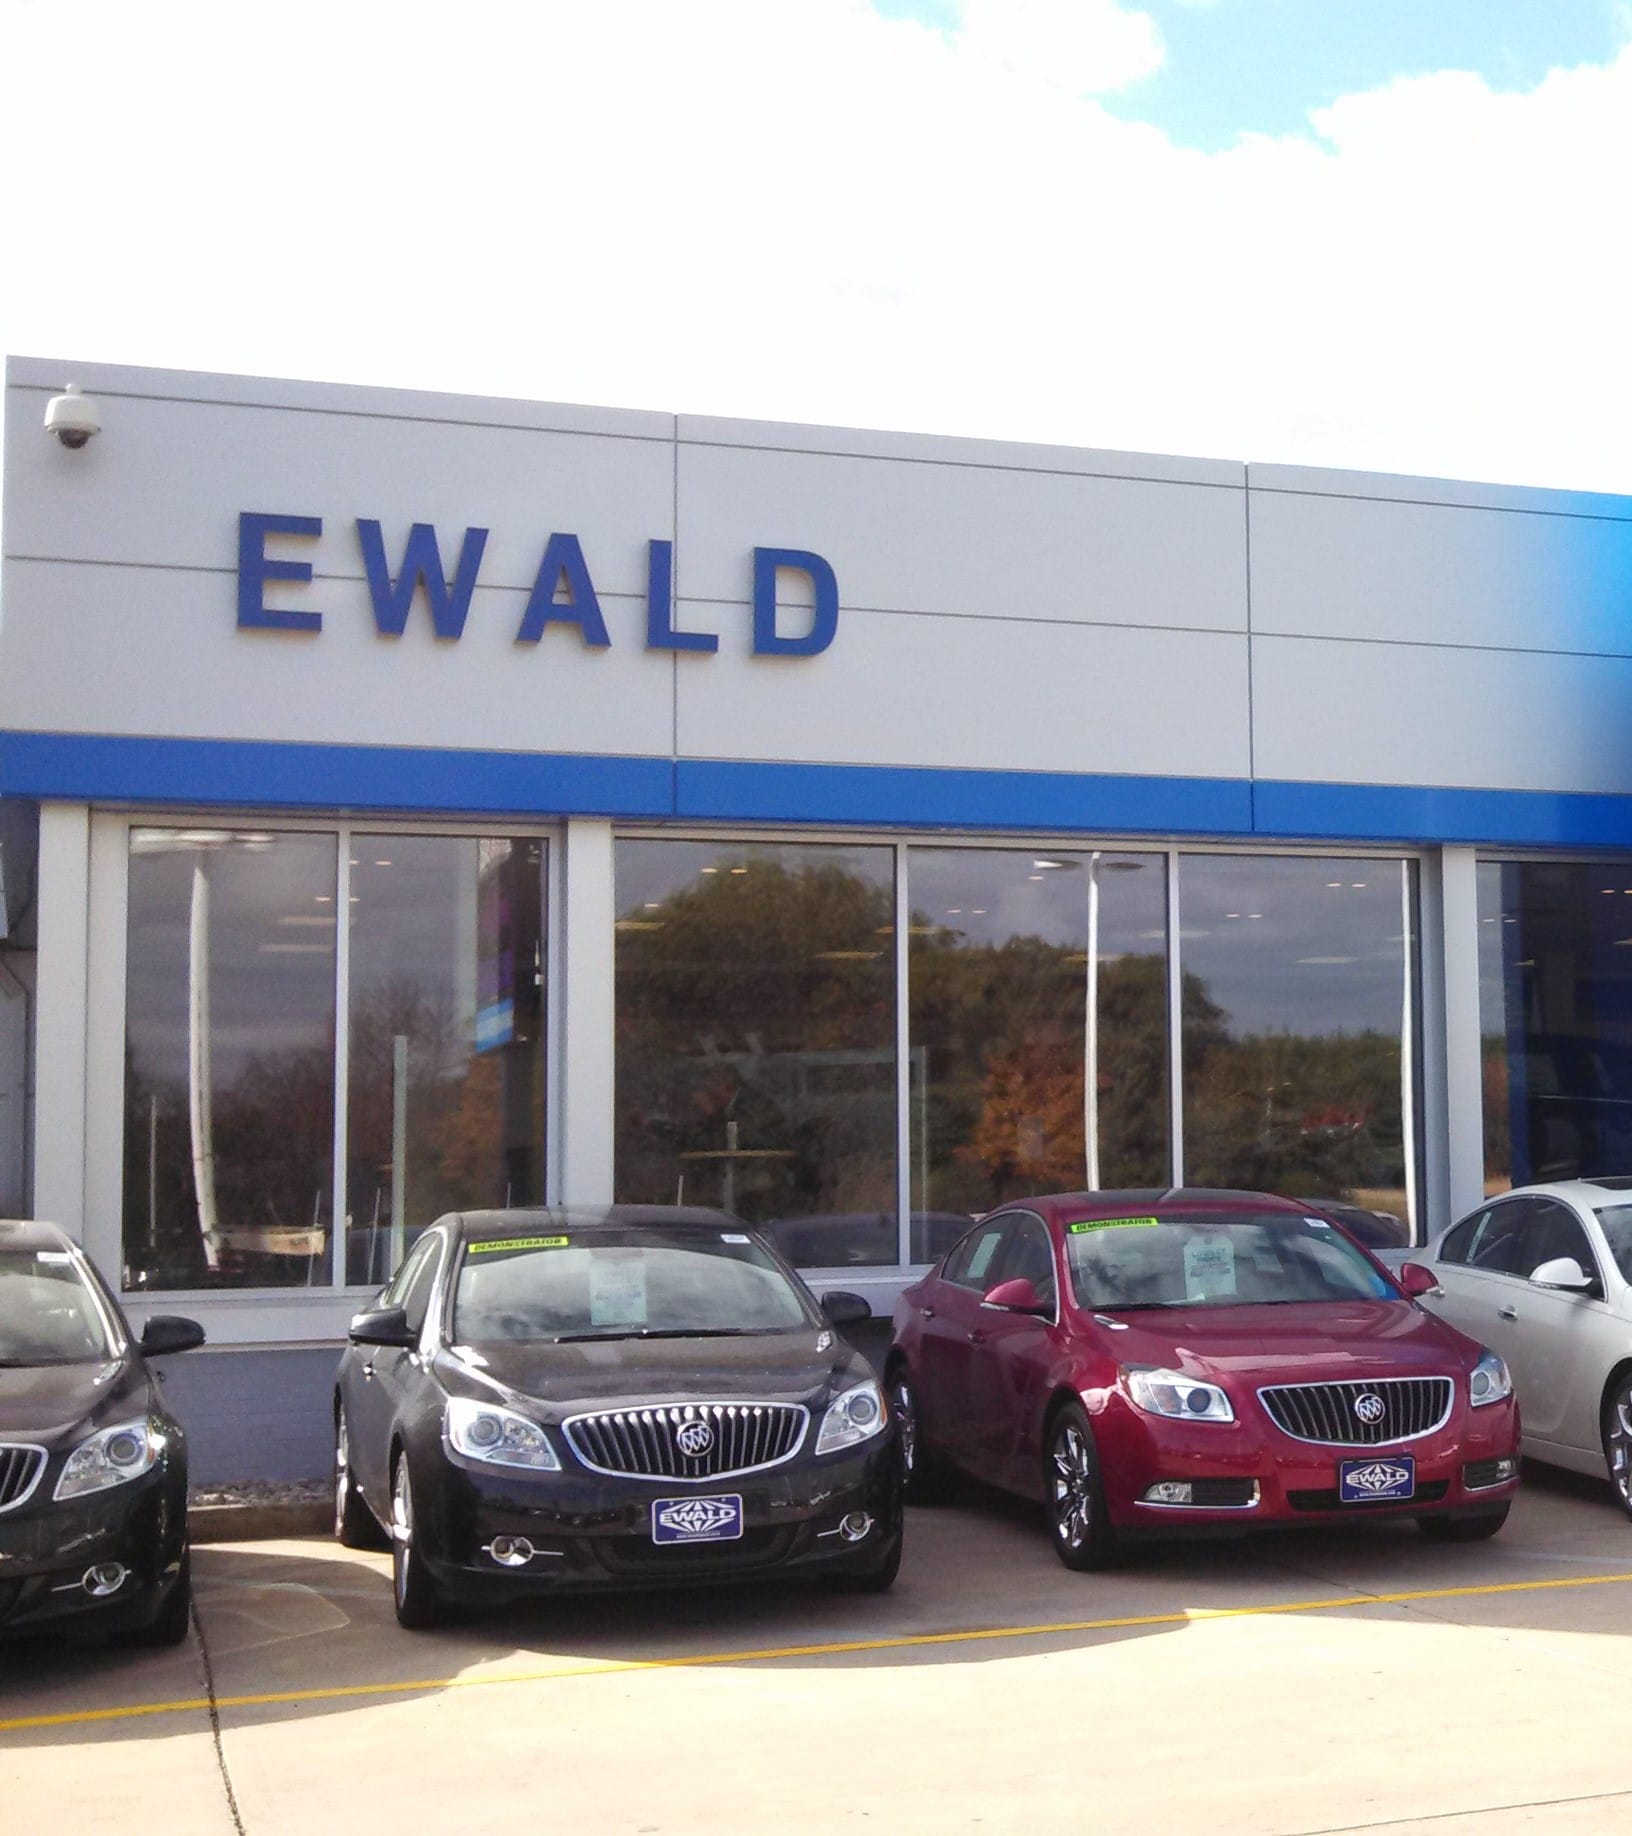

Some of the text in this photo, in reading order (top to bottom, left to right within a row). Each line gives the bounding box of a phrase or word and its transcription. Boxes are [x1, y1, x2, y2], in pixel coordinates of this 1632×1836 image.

[237, 512, 839, 657] EWALD
[1346, 1471, 1409, 1483] EWALD
[660, 1509, 737, 1523] EWALD
